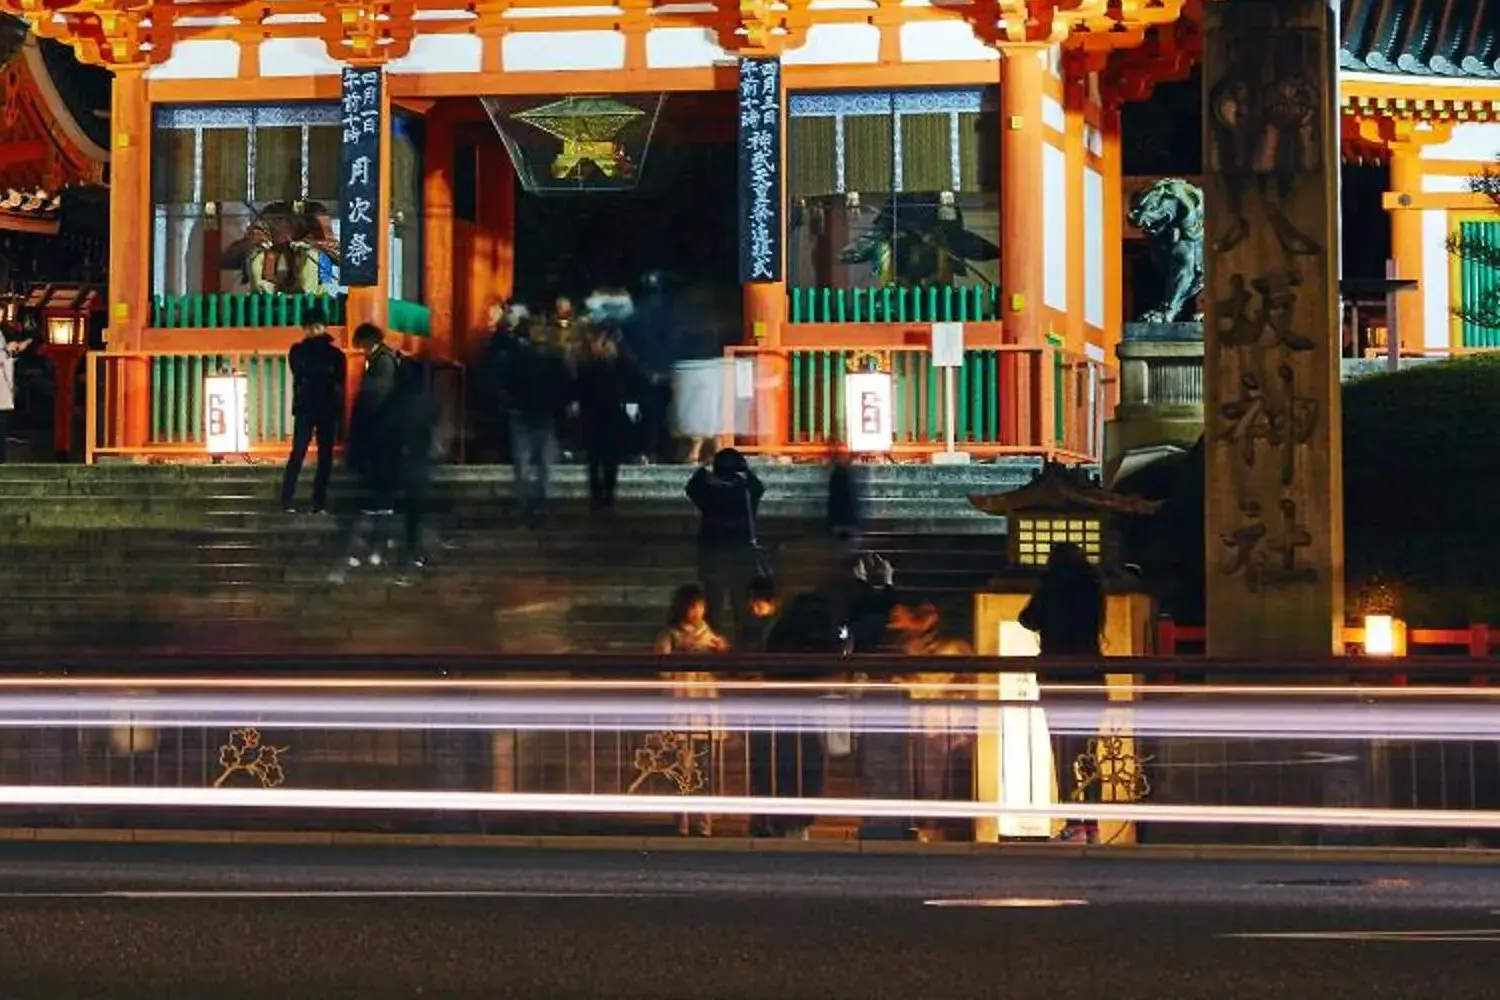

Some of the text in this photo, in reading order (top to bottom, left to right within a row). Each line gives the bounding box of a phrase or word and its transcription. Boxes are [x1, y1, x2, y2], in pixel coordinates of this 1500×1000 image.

[347, 155, 373, 266] 月次祭
[1212, 174, 1322, 590] 八坂神社
